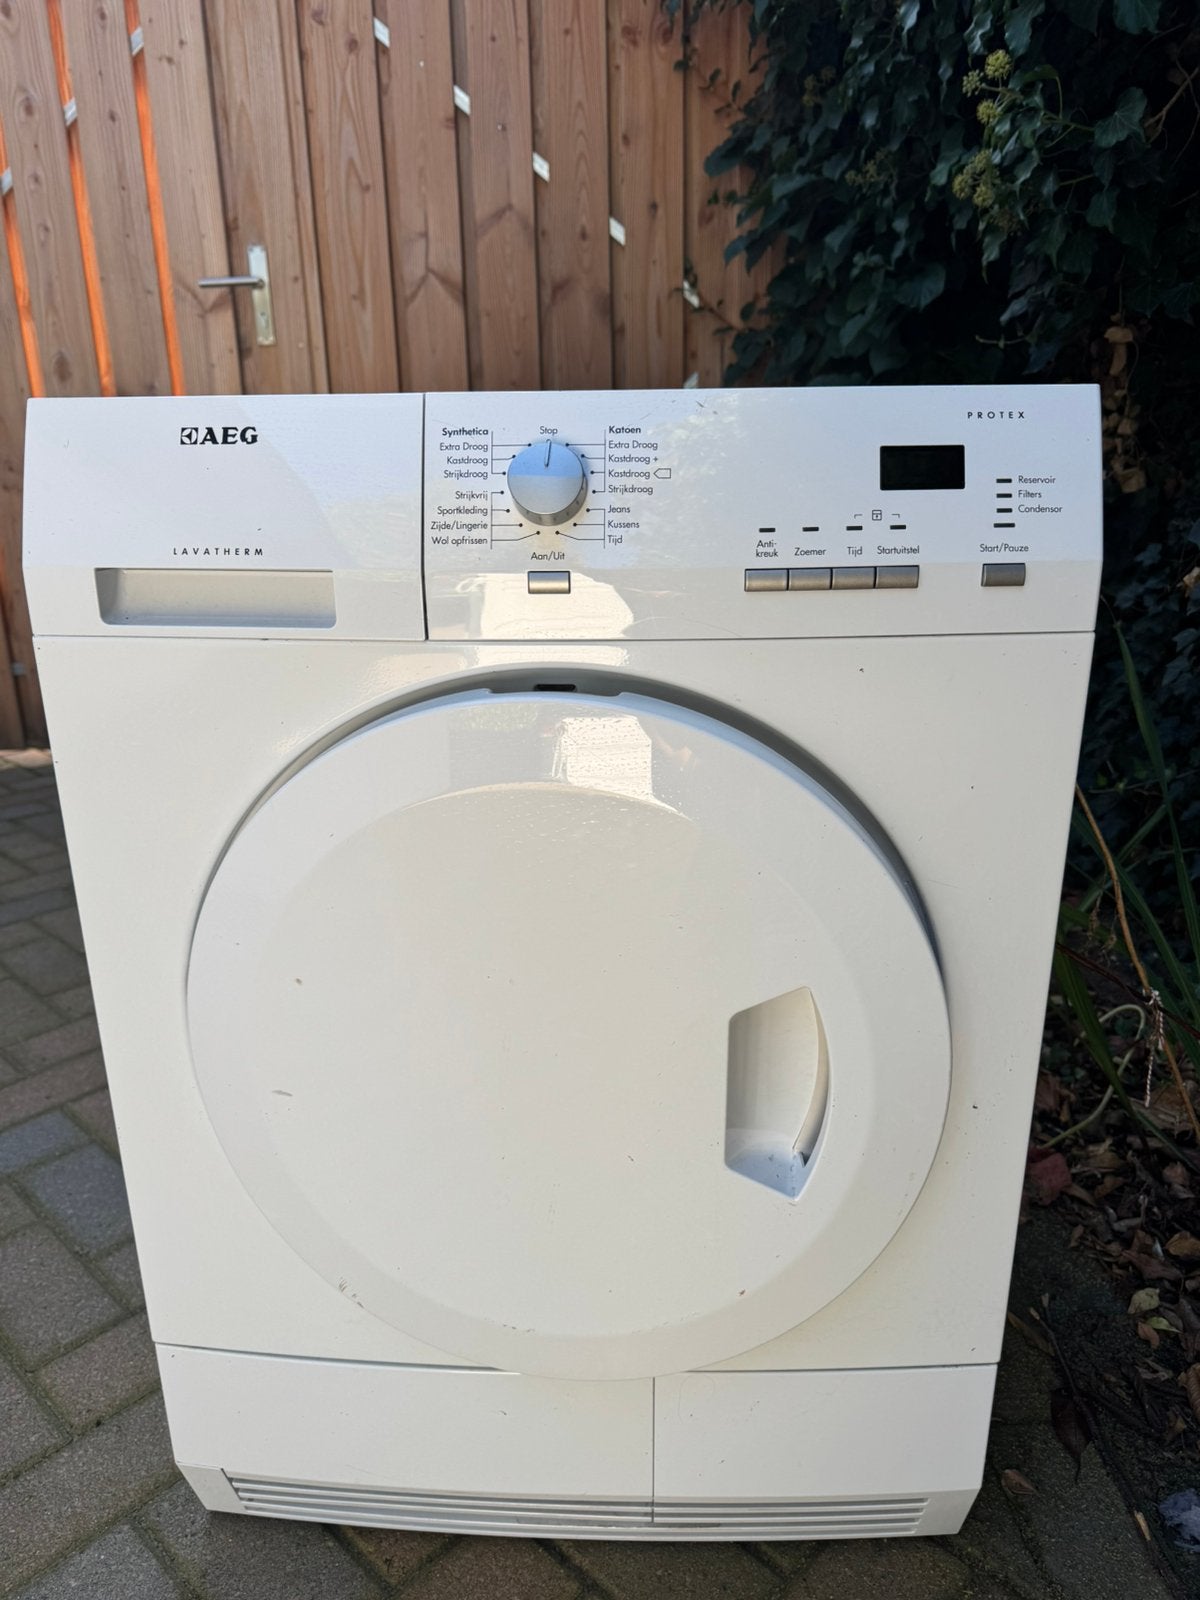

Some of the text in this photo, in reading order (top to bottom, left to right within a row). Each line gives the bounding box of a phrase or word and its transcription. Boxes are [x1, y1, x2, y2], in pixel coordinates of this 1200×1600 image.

[442, 427, 489, 437] Synthetica
[540, 426, 558, 436] Stop
[608, 426, 642, 434] Katoen
[200, 426, 258, 446] AEG
[440, 442, 488, 452] Extra Droog
[608, 440, 658, 450] Extra Droog
[446, 456, 488, 466] Kastdroog
[608, 454, 651, 464] Kastdroog
[444, 470, 488, 480] Strijkdroog
[608, 469, 651, 479] Kastdroog
[1018, 475, 1056, 484] Reservoir
[608, 485, 654, 495] Strijkdroog
[1018, 490, 1042, 499] Filters
[455, 490, 488, 501] Strijkvrij
[437, 506, 488, 516] Sportkleding
[1018, 504, 1063, 514] Condensor
[431, 521, 488, 531] Zijde/Lingerie
[608, 520, 640, 528] Kussens
[431, 536, 488, 547] Wol opfrissen
[608, 535, 623, 545] Tijd
[756, 540, 777, 549] Anti-
[173, 547, 264, 556] LAVATHERM
[794, 548, 826, 556] Zoemer
[847, 546, 863, 556] Tijd
[876, 545, 920, 555] Startuitstel
[980, 543, 1029, 553] Start/Pauze
[530, 552, 565, 561] Aan/Uit
[755, 549, 778, 558] kreuk
